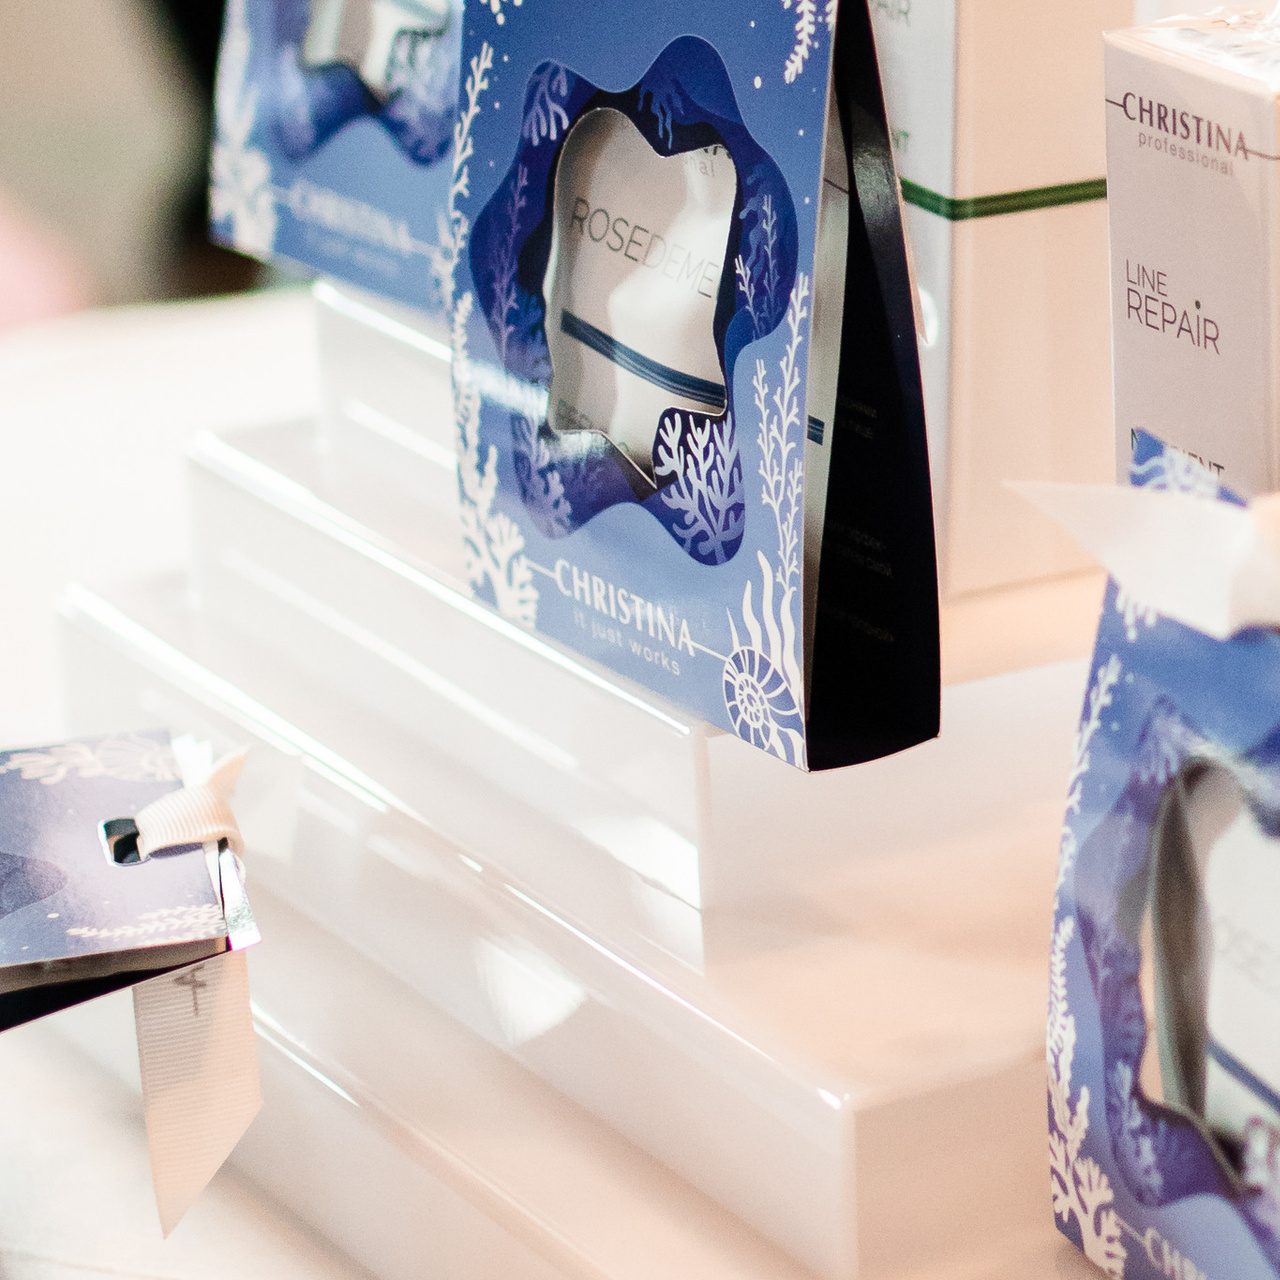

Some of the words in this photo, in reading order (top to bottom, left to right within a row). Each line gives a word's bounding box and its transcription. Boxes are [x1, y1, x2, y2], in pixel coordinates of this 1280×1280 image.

[1123, 91, 1249, 162] CHRISTINA
[1138, 132, 1235, 177] professional
[1125, 258, 1168, 298] LINE
[555, 557, 697, 658] CHRISTINA
[630, 639, 681, 677] works
